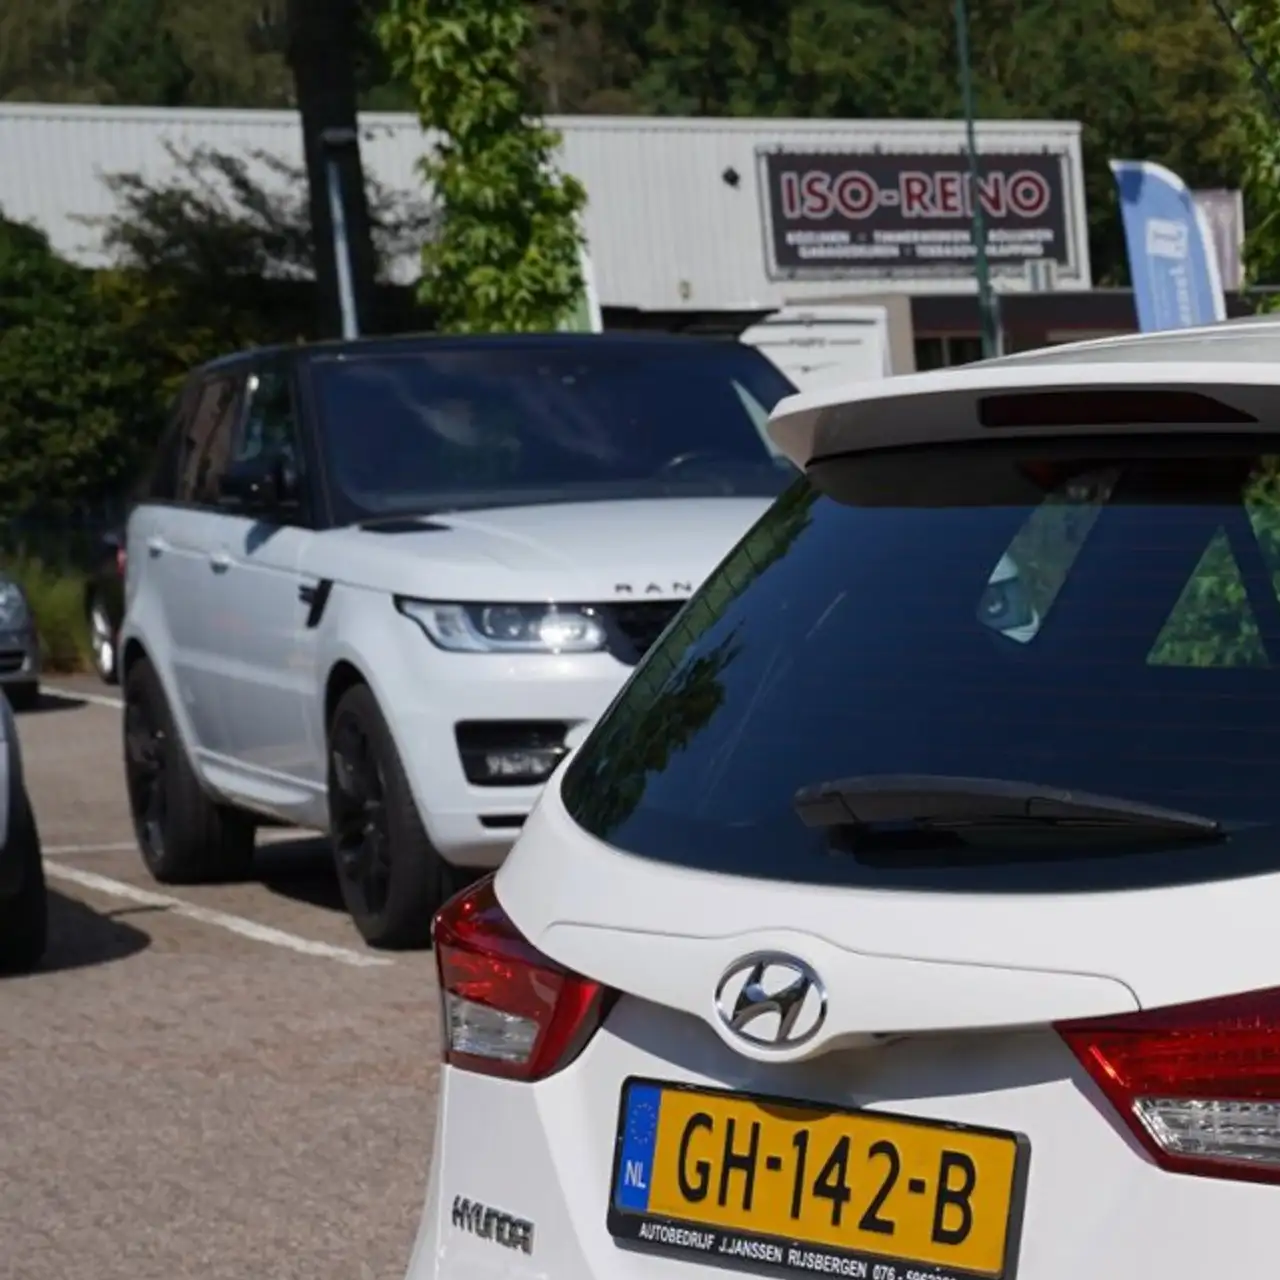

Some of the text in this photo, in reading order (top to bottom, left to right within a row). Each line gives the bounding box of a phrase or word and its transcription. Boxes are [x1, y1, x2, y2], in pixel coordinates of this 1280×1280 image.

[781, 171, 1051, 219] ISO-RENO
[624, 1159, 647, 1190] NL
[677, 1112, 977, 1246] GH-142-B
[638, 1222, 716, 1252] AUTOBEDRIJF
[788, 1249, 868, 1279] RIJSBERGEN
